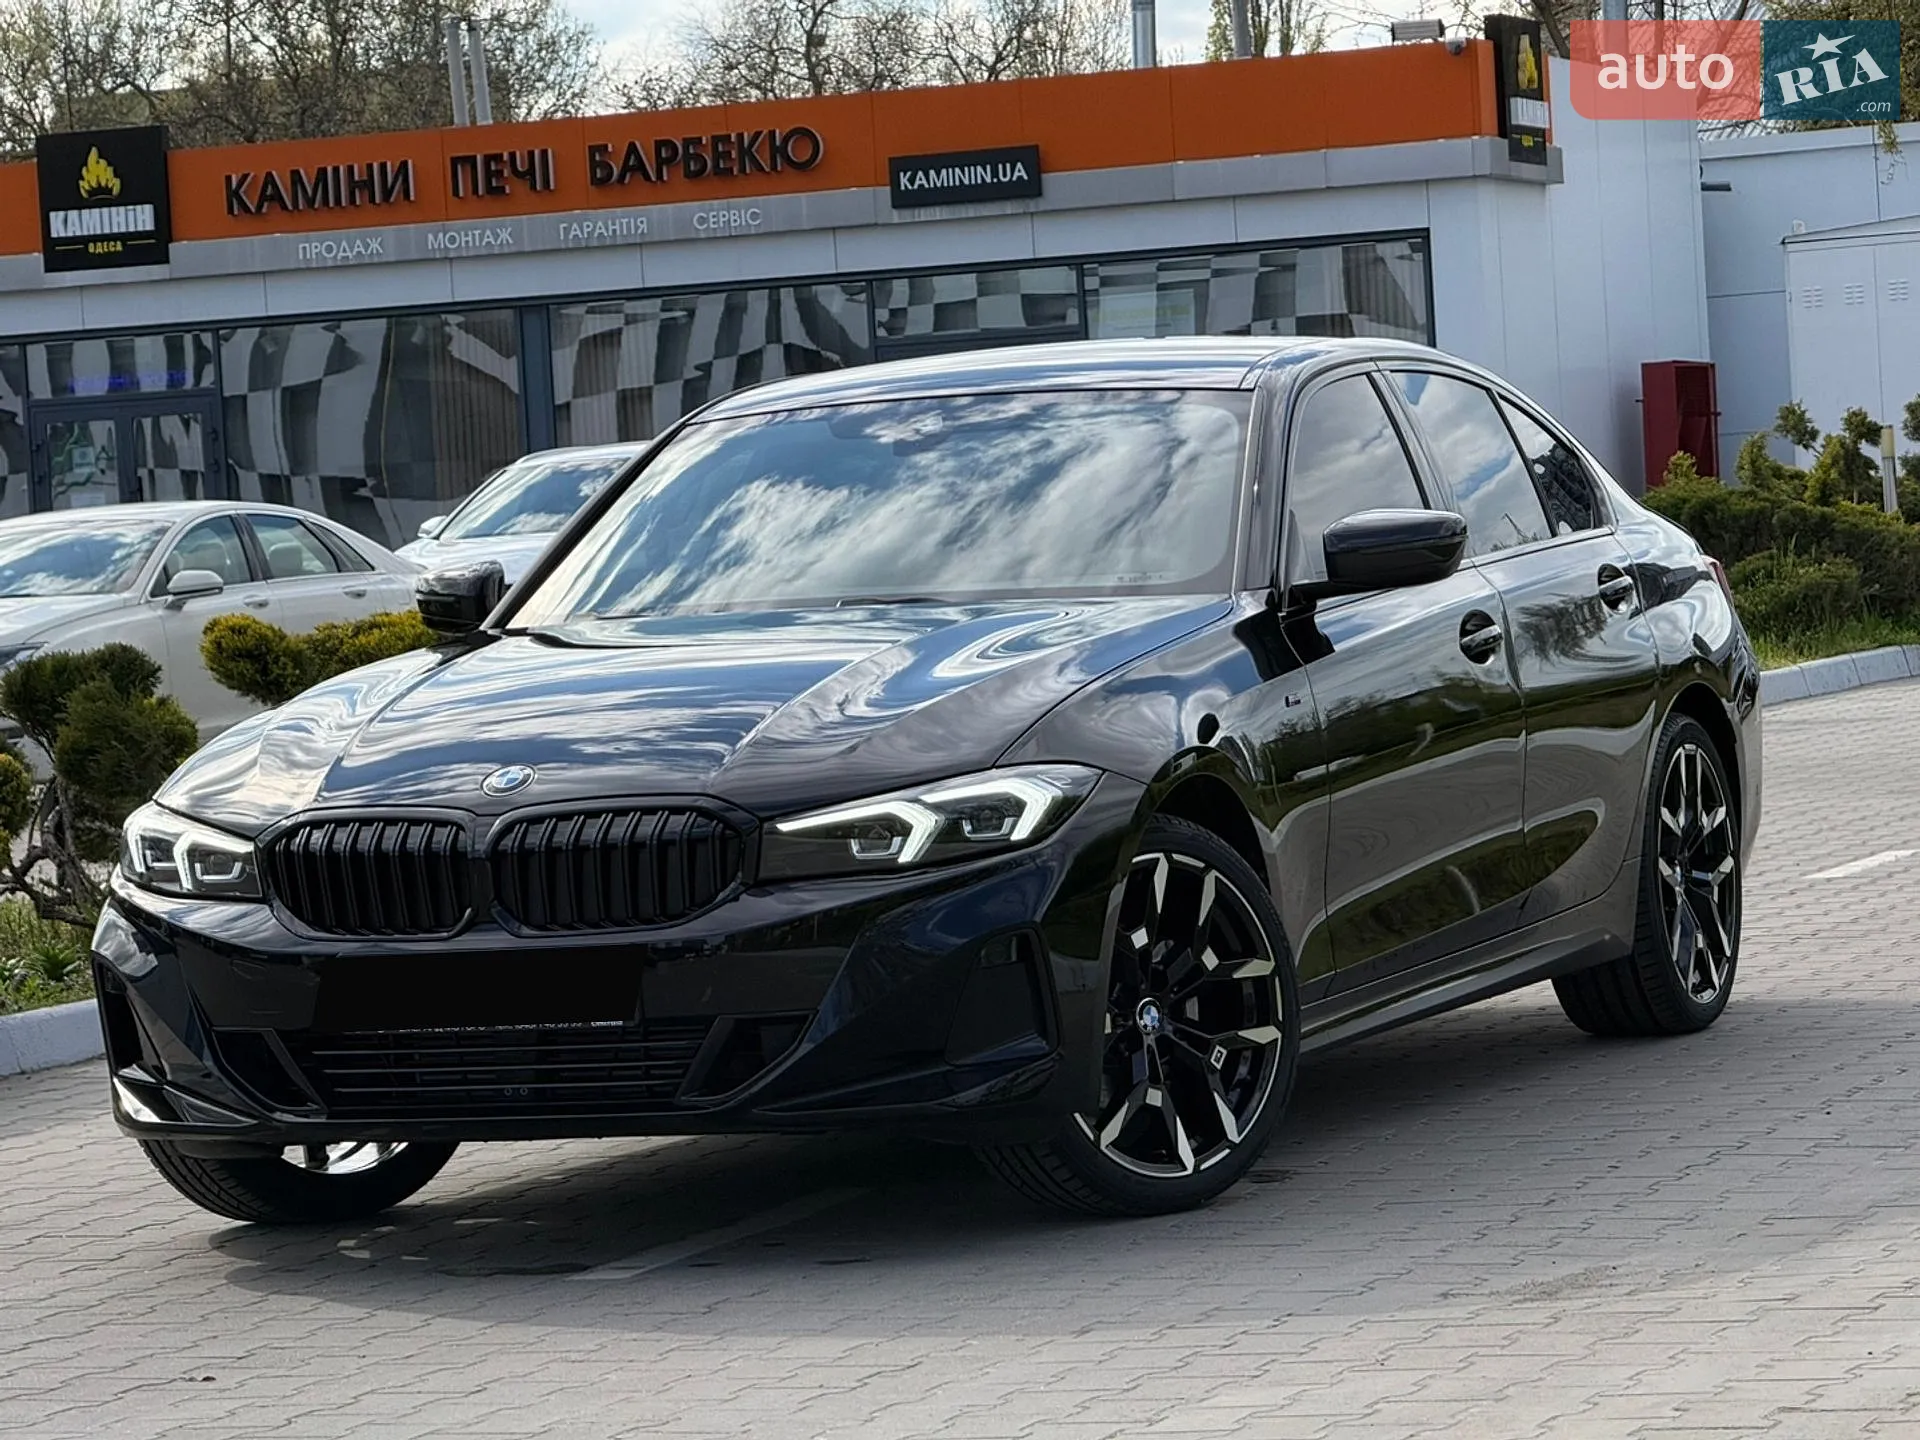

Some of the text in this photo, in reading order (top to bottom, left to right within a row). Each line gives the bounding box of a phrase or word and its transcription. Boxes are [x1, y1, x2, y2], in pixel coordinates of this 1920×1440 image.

[225, 126, 824, 216] КАМІНИ ПЕЧІ БАРБЕКЮ
[899, 161, 1029, 191] KAMININ.UA
[298, 207, 762, 262] ПРОДАЖ МОНТАЖ ГАРАНТІЯ СЕРВІС
